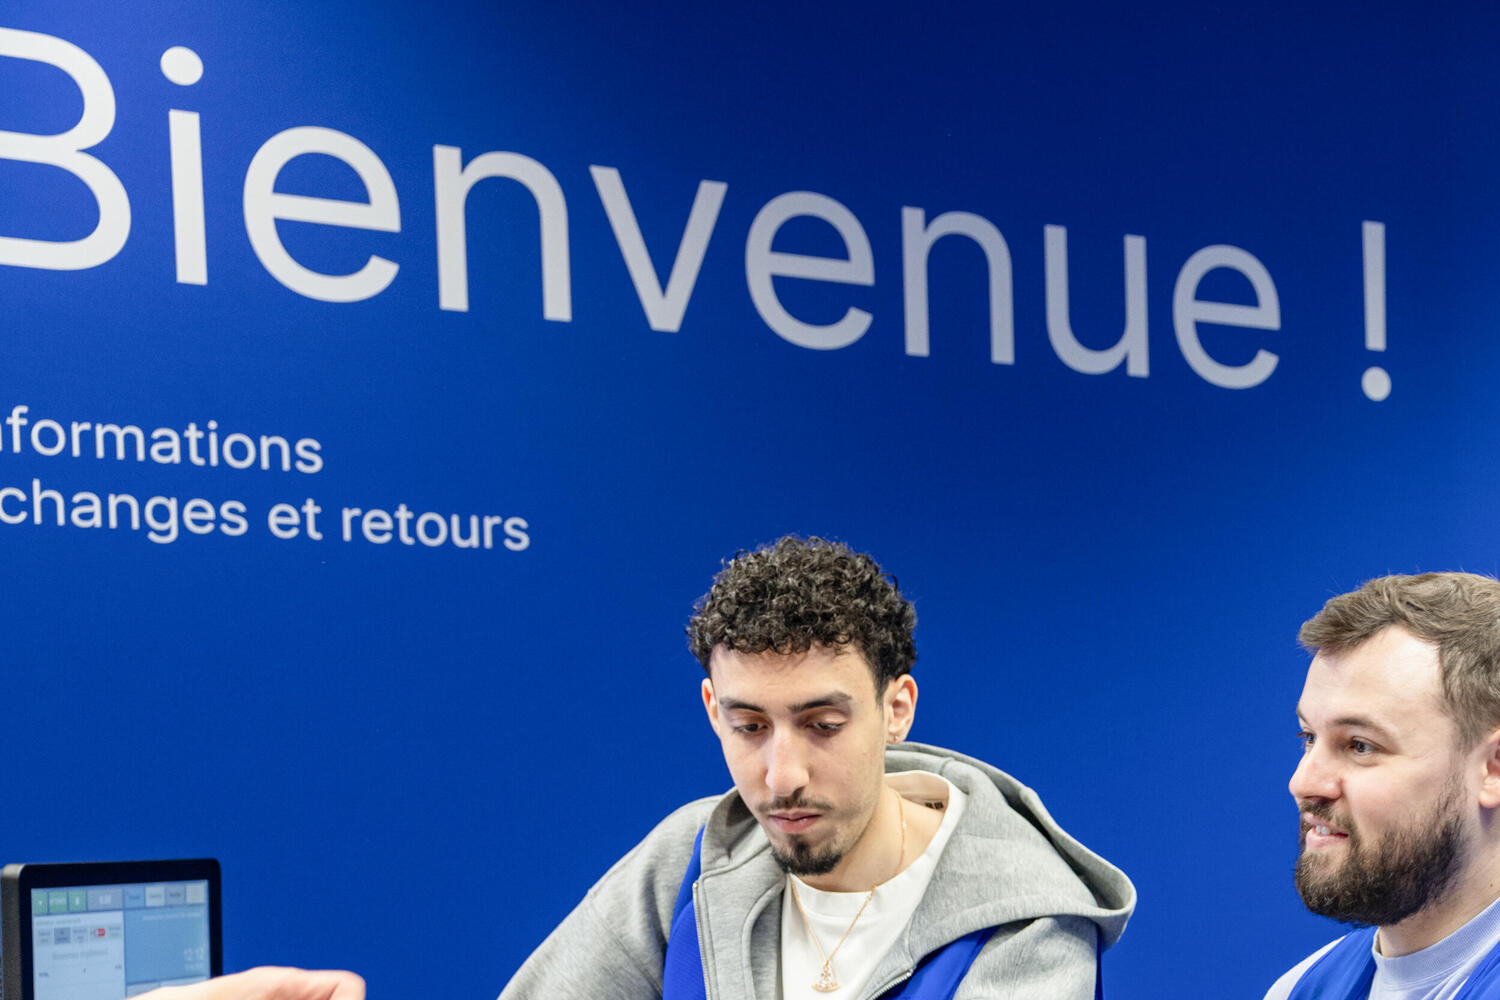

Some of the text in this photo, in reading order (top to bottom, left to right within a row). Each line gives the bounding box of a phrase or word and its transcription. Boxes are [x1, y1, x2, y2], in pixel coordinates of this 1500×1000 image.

[0, 26, 1392, 402] Bienvenue !
[0, 405, 323, 474] formations
[267, 498, 323, 541] et
[342, 503, 530, 551] retours
